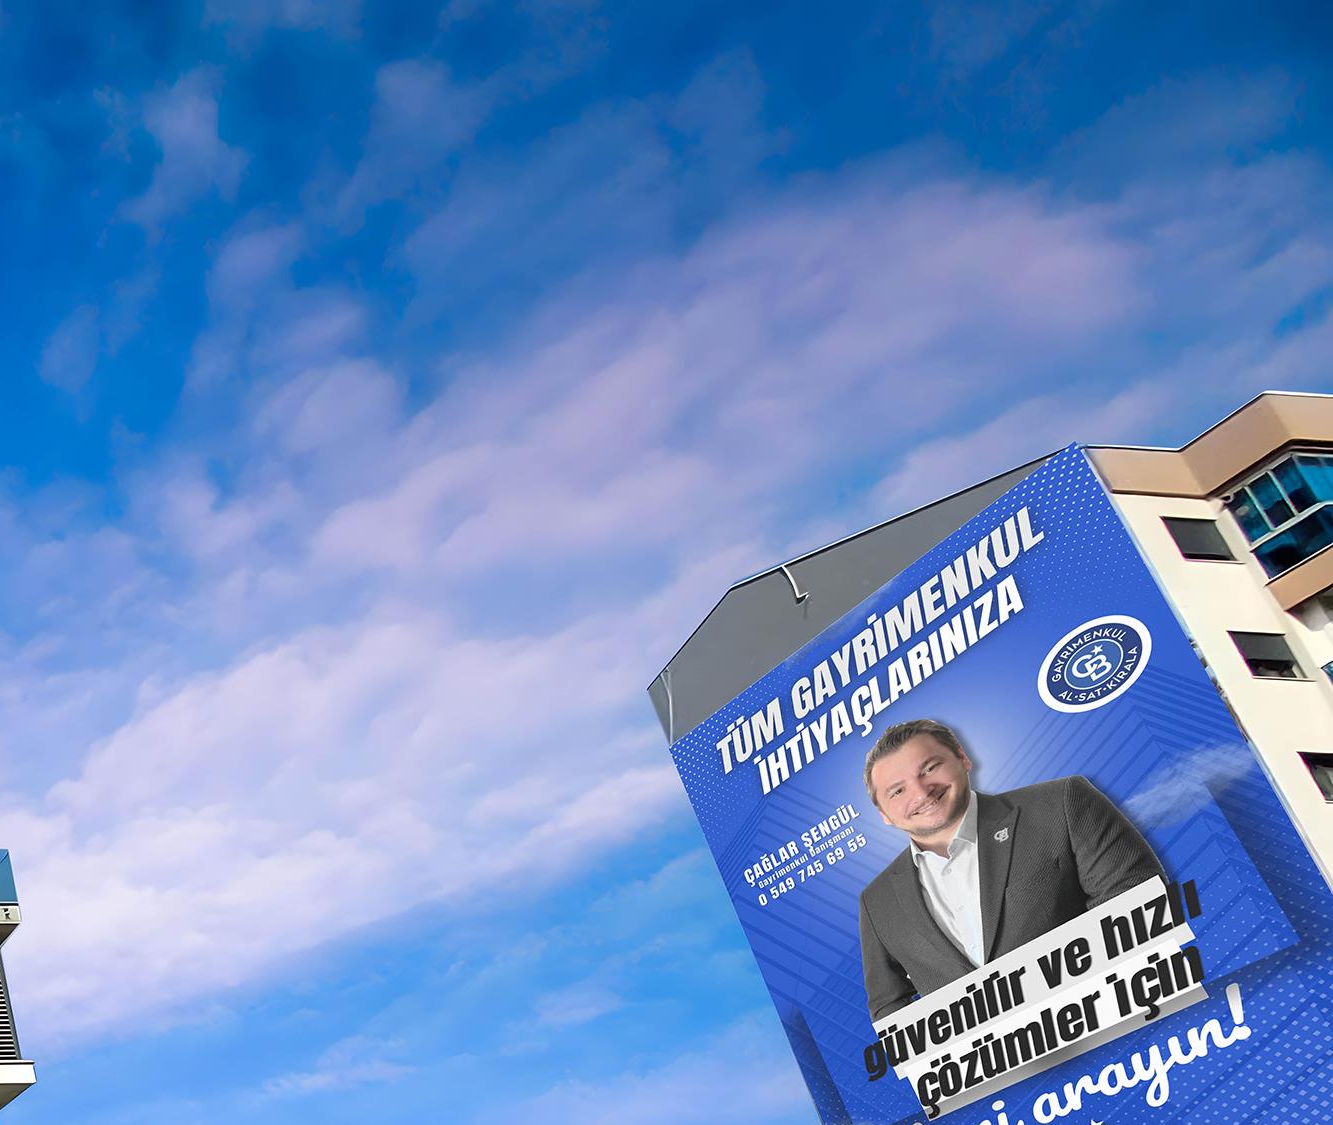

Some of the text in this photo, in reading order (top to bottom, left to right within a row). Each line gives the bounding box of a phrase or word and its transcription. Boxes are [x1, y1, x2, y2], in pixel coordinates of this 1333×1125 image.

[716, 505, 1045, 775] TÜM GAYRİMENKUL
[753, 574, 1024, 796] İHTİYAÇLARINIZA
[743, 804, 860, 888] ÇAĞLAR ŞENGÜL
[758, 833, 867, 906] 0 549 745 69 55
[758, 853, 809, 889] Gayrimenkul
[863, 878, 1203, 1083] güvenilir ve hızlı
[917, 946, 1206, 1120] çözümler için
[1032, 982, 1252, 1124] arayın!
